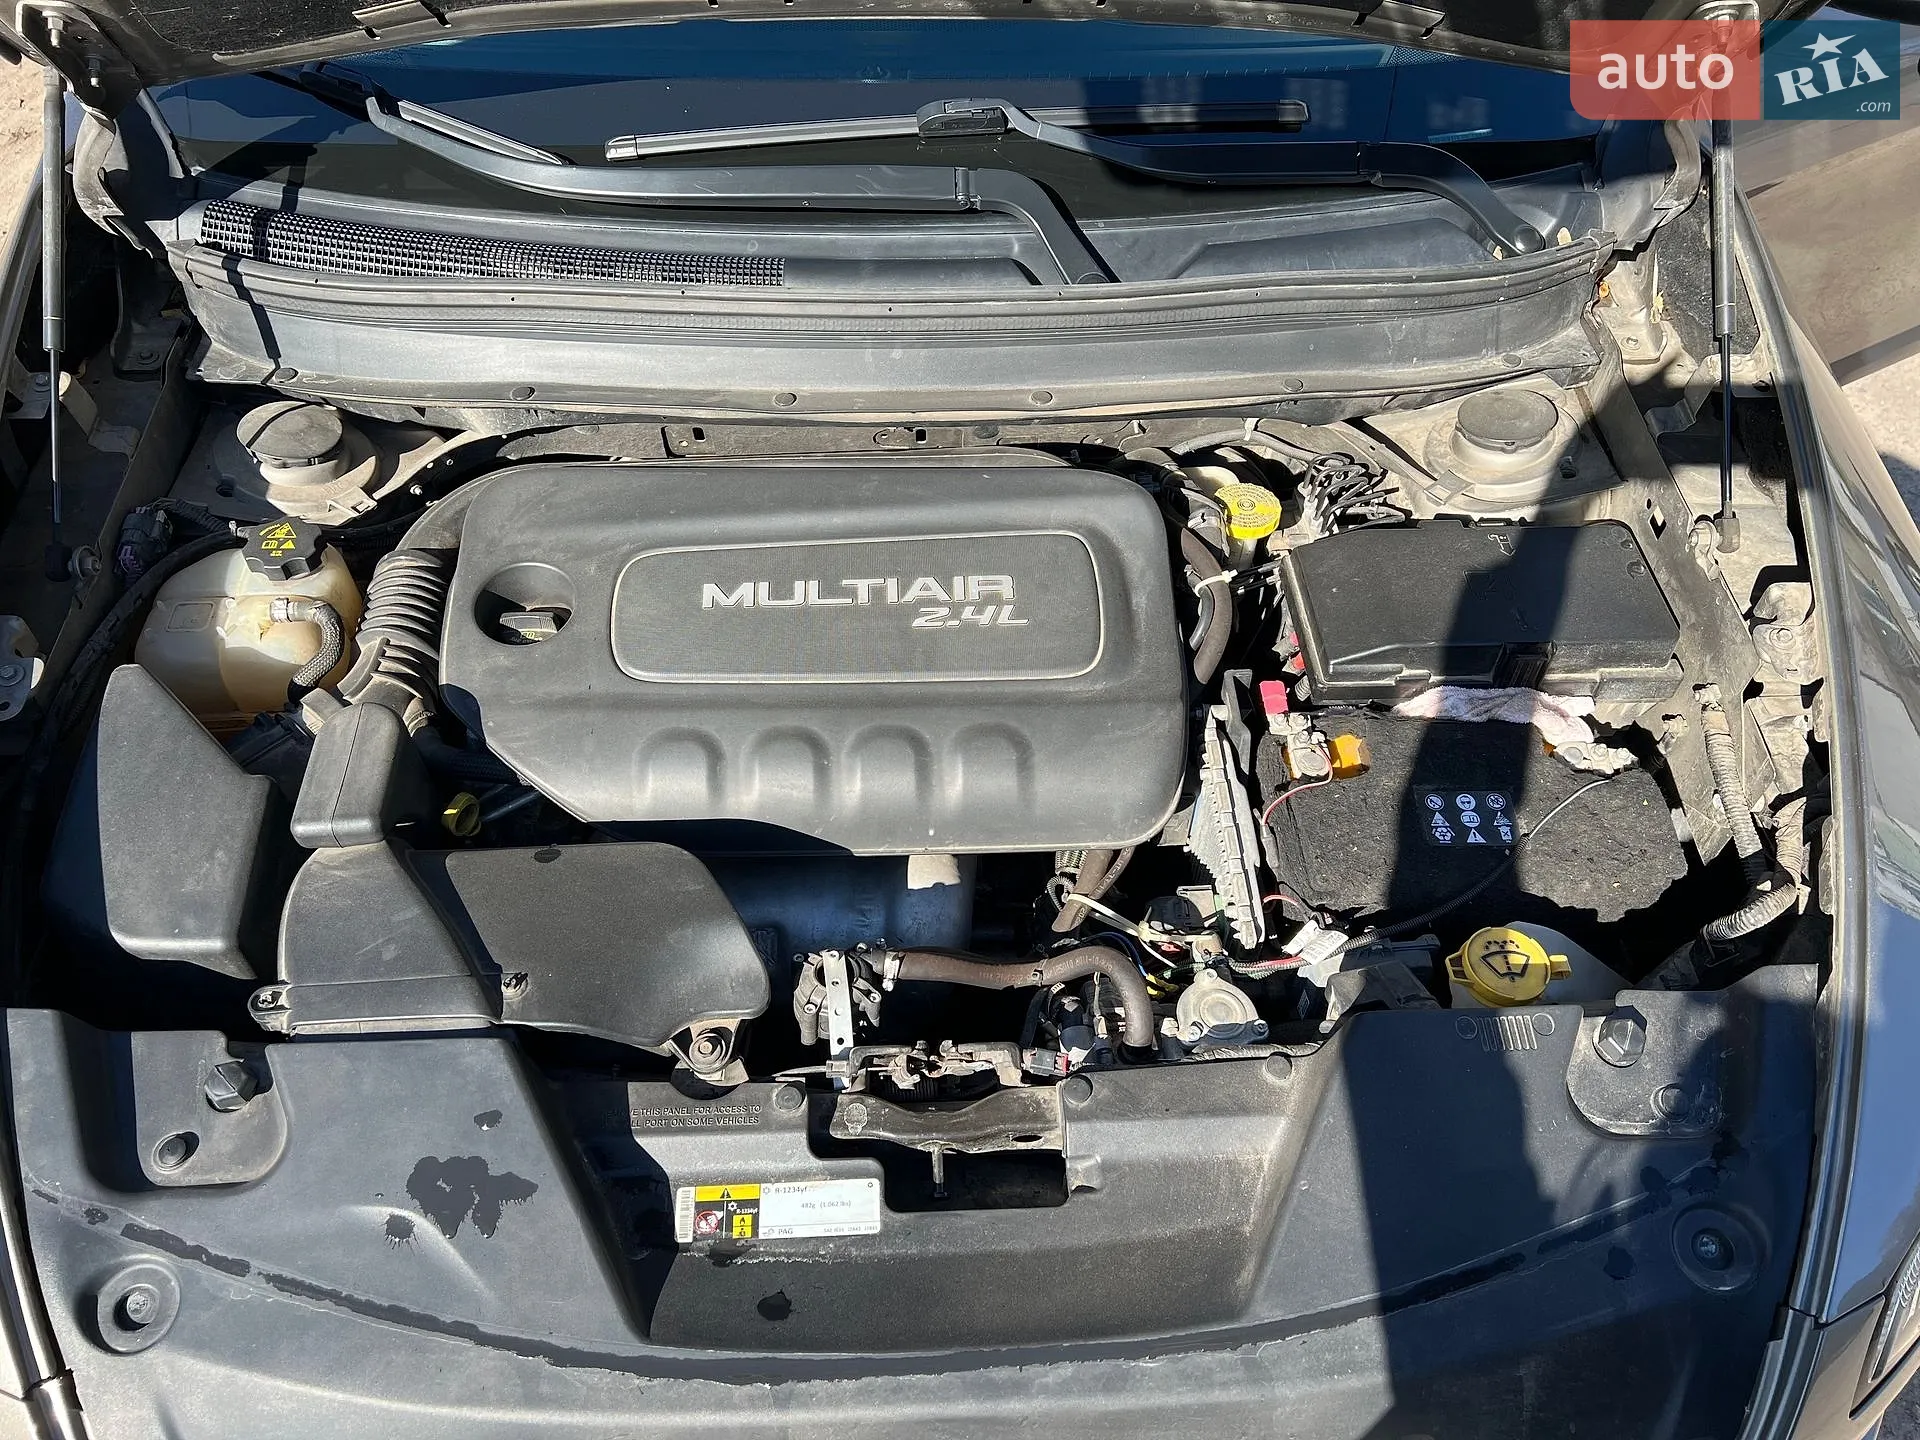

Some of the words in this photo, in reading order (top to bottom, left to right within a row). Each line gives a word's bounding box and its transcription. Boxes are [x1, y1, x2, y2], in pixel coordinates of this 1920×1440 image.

[702, 574, 1016, 609] MULTIAIR
[912, 604, 1031, 629] 2.4L
[641, 1107, 661, 1117] THIS
[662, 1106, 692, 1116] PANEL
[693, 1105, 711, 1115] FOR
[713, 1105, 748, 1115] ACCESS
[749, 1104, 762, 1114] TO
[644, 1118, 668, 1129] PORT
[671, 1118, 686, 1128] ON
[687, 1117, 713, 1127] SOME
[715, 1115, 760, 1126] VEHICLES
[774, 1186, 808, 1196] R-1234yf
[778, 1227, 794, 1236] PAG
